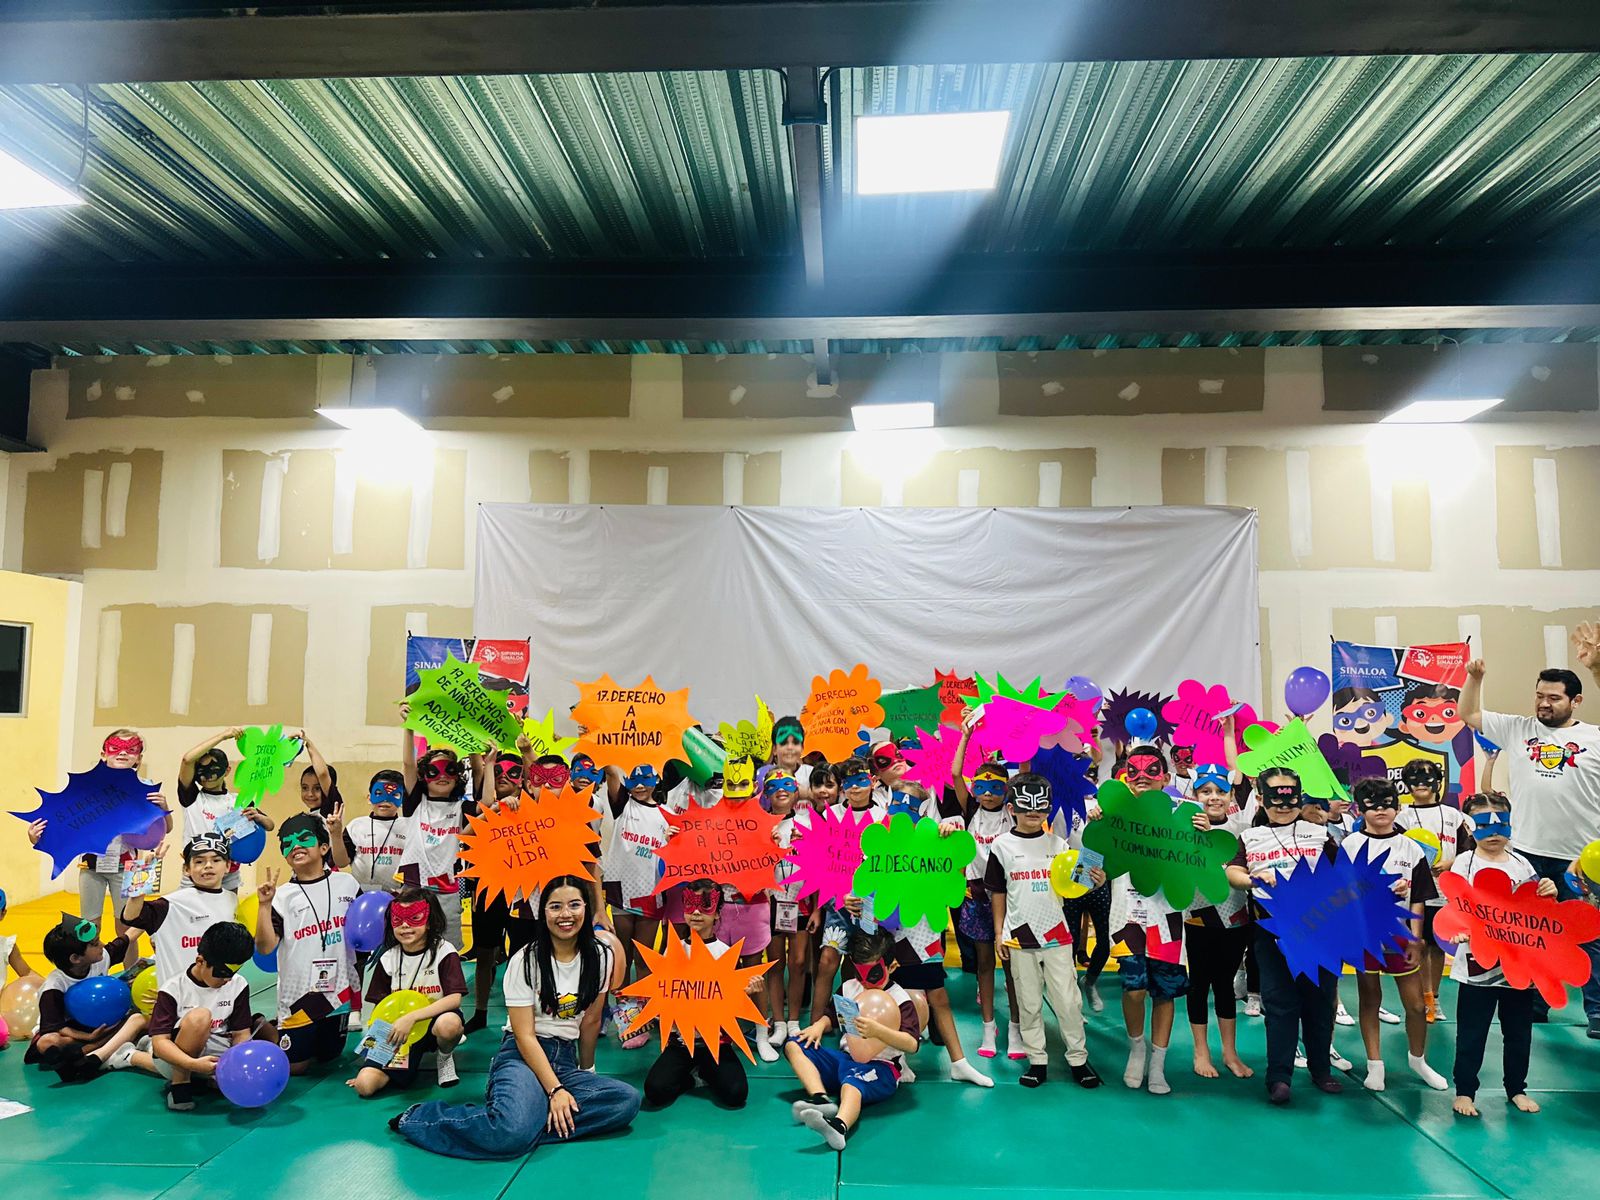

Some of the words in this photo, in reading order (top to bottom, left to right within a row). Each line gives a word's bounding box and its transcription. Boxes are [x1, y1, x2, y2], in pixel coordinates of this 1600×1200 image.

[414, 660, 442, 670] SINA
[1340, 666, 1387, 676] SINALOA
[436, 675, 452, 691] DE
[461, 679, 507, 724] DERECHOS
[815, 689, 857, 702] DERECHO
[452, 711, 466, 722] Y
[626, 705, 635, 717] A
[622, 719, 637, 732] LA
[419, 713, 478, 754] MIGRANTES
[597, 731, 663, 747] INTIMIDAD
[489, 817, 556, 843] DERECHO
[682, 818, 758, 832] DERECHO
[640, 834, 650, 845] de
[697, 834, 707, 847] A
[718, 832, 738, 846] LA
[1128, 820, 1214, 849] TECNOLOGÍAS
[506, 839, 517, 853] A
[520, 833, 540, 847] LA
[503, 846, 549, 869] VIDA
[710, 850, 733, 863] NO
[1120, 838, 1207, 868] COMUNICACIÓN
[1268, 849, 1280, 860] de
[666, 852, 780, 878] DISCRIMINACIÓN
[1010, 870, 1030, 881] Curso
[1031, 868, 1041, 880] de
[1031, 881, 1049, 893] 2025
[181, 935, 202, 948] Cur
[1485, 926, 1547, 950] JURÍDICA
